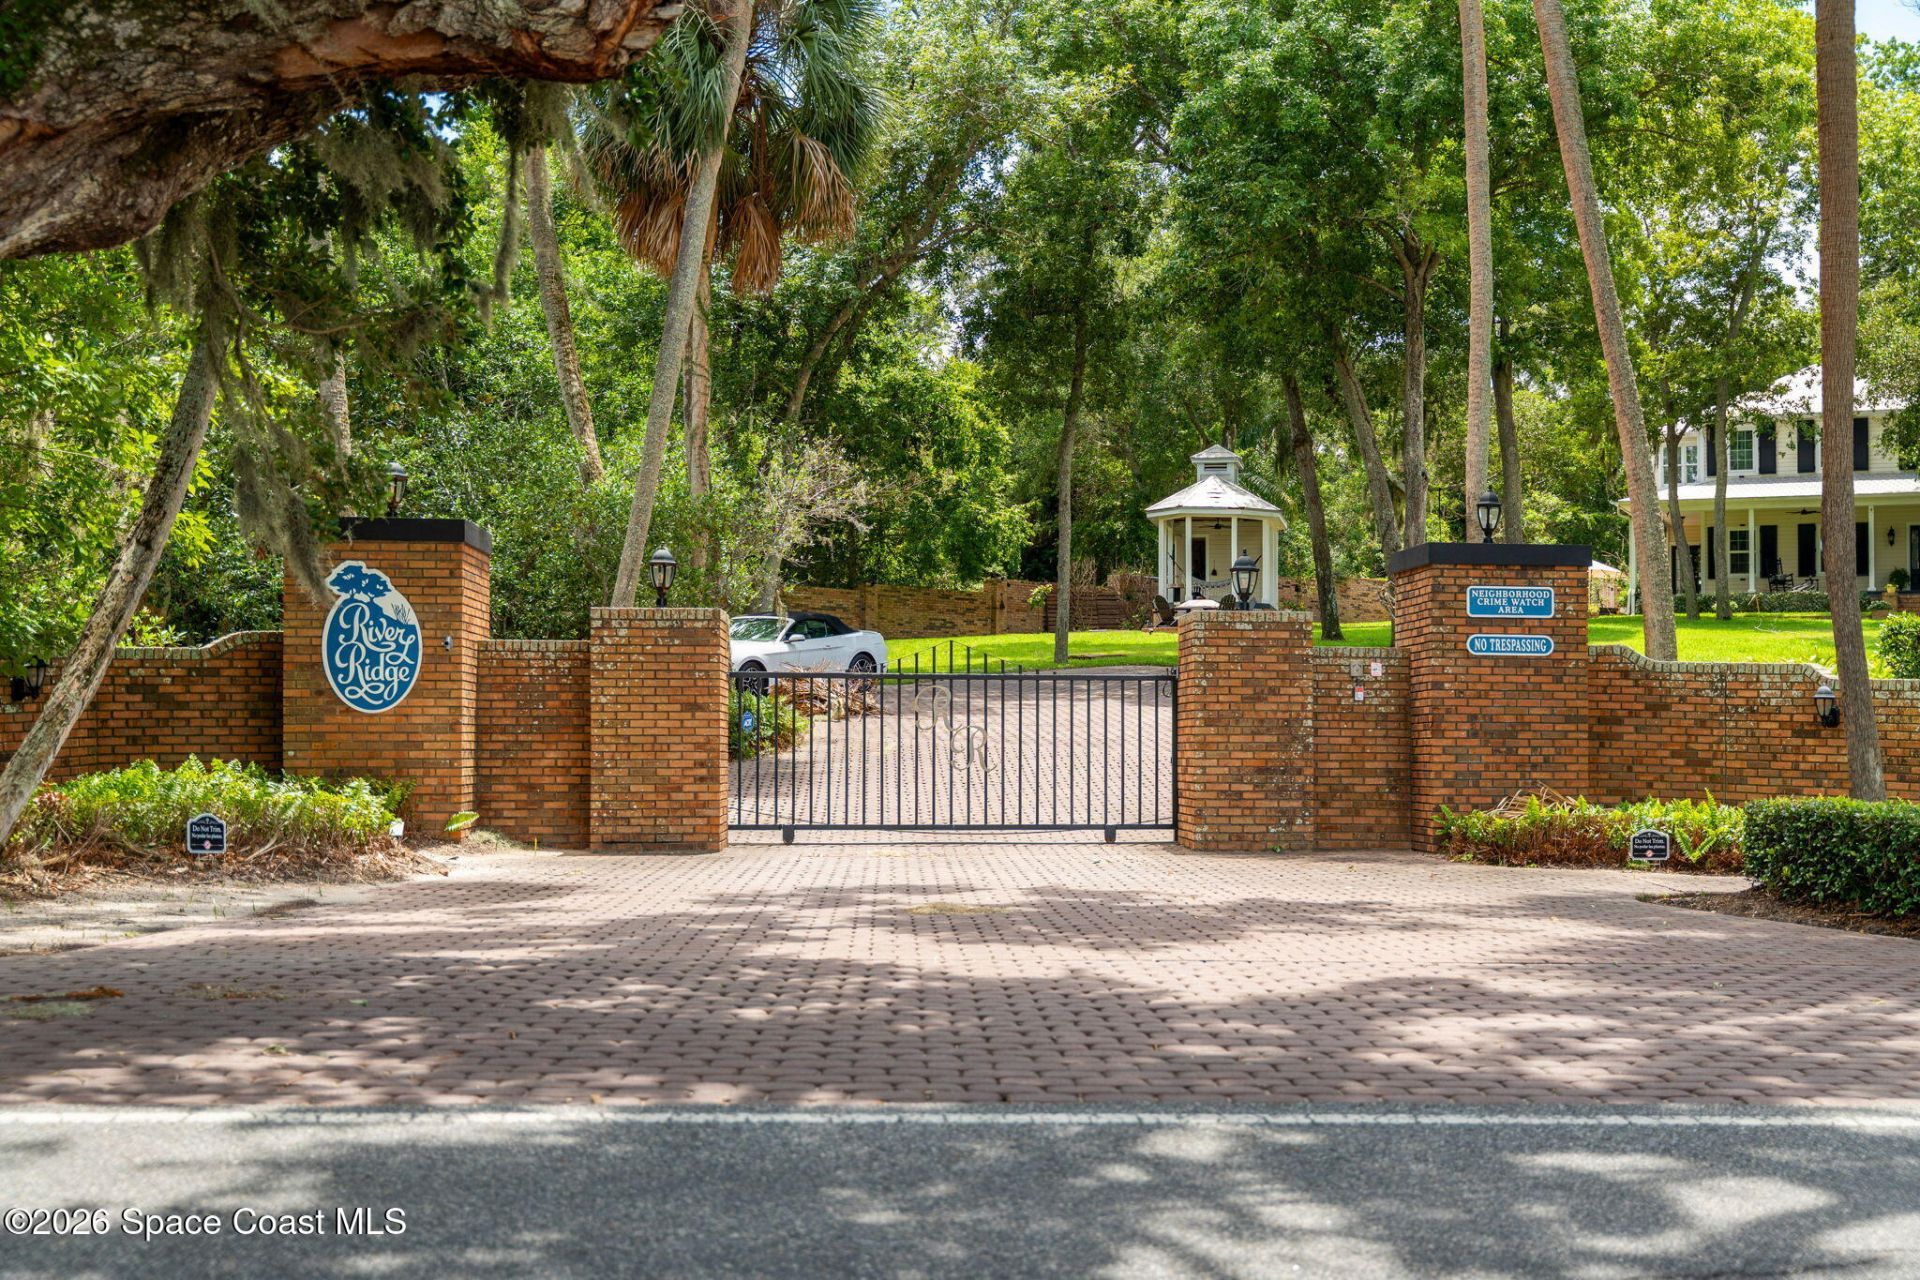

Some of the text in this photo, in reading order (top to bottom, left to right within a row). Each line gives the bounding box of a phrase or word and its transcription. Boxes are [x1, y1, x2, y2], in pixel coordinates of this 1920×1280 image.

[1471, 590, 1550, 599] NEIGHBORHOOD
[1477, 597, 1545, 607] CRIME WATCH
[1498, 606, 1524, 614] AREA
[338, 602, 416, 665] River
[1474, 638, 1547, 652] NO TRESPASSING
[335, 641, 410, 705] Ridge
[192, 824, 200, 832] Do
[200, 824, 209, 832] Not
